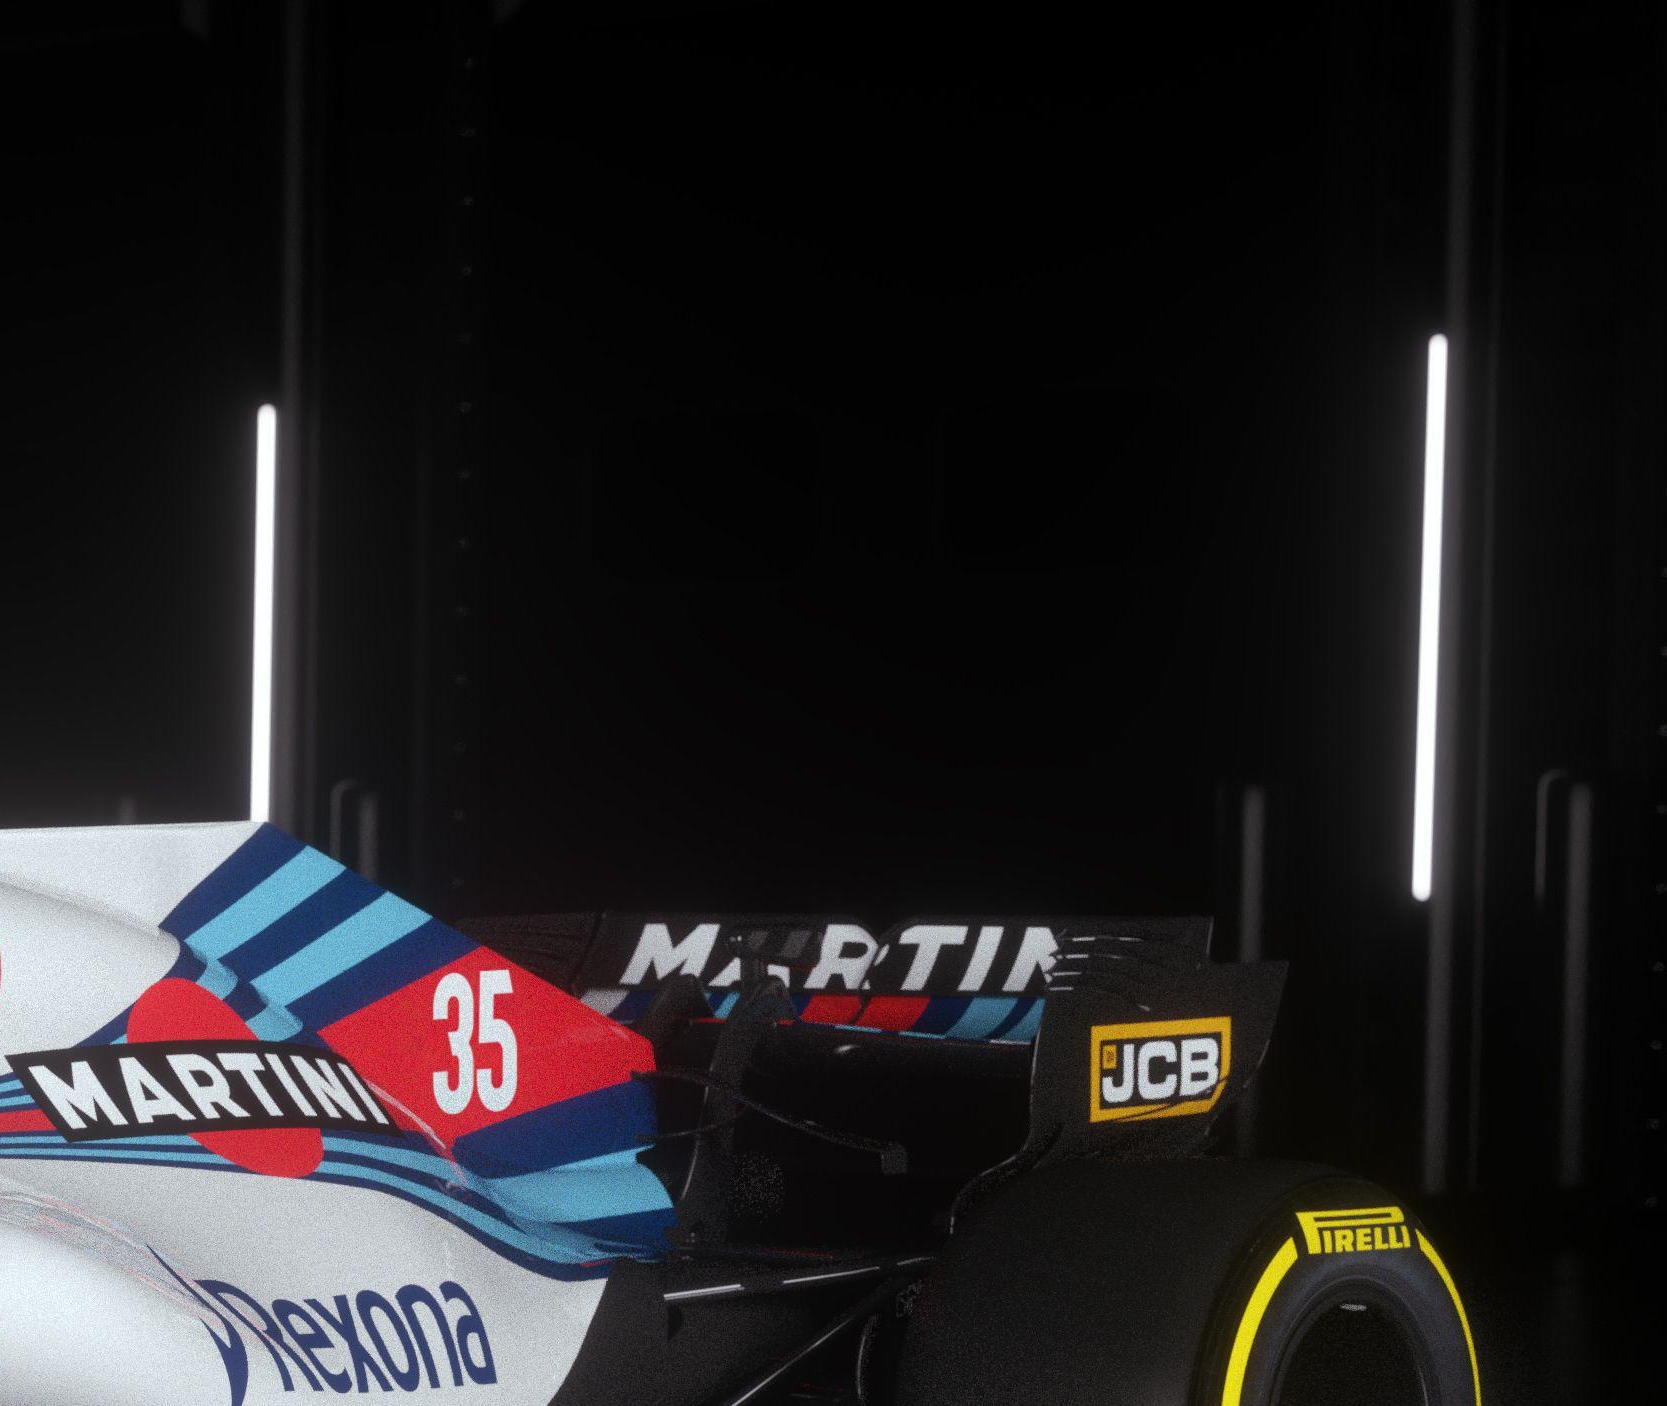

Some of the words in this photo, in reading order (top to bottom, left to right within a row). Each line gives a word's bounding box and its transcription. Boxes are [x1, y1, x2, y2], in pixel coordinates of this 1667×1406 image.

[431, 969, 518, 1115] 35
[1102, 1037, 1219, 1104] JCB
[28, 1052, 390, 1131] MARTINI
[1295, 1206, 1411, 1255] PIRELLI
[194, 1279, 498, 1394] Rexona
